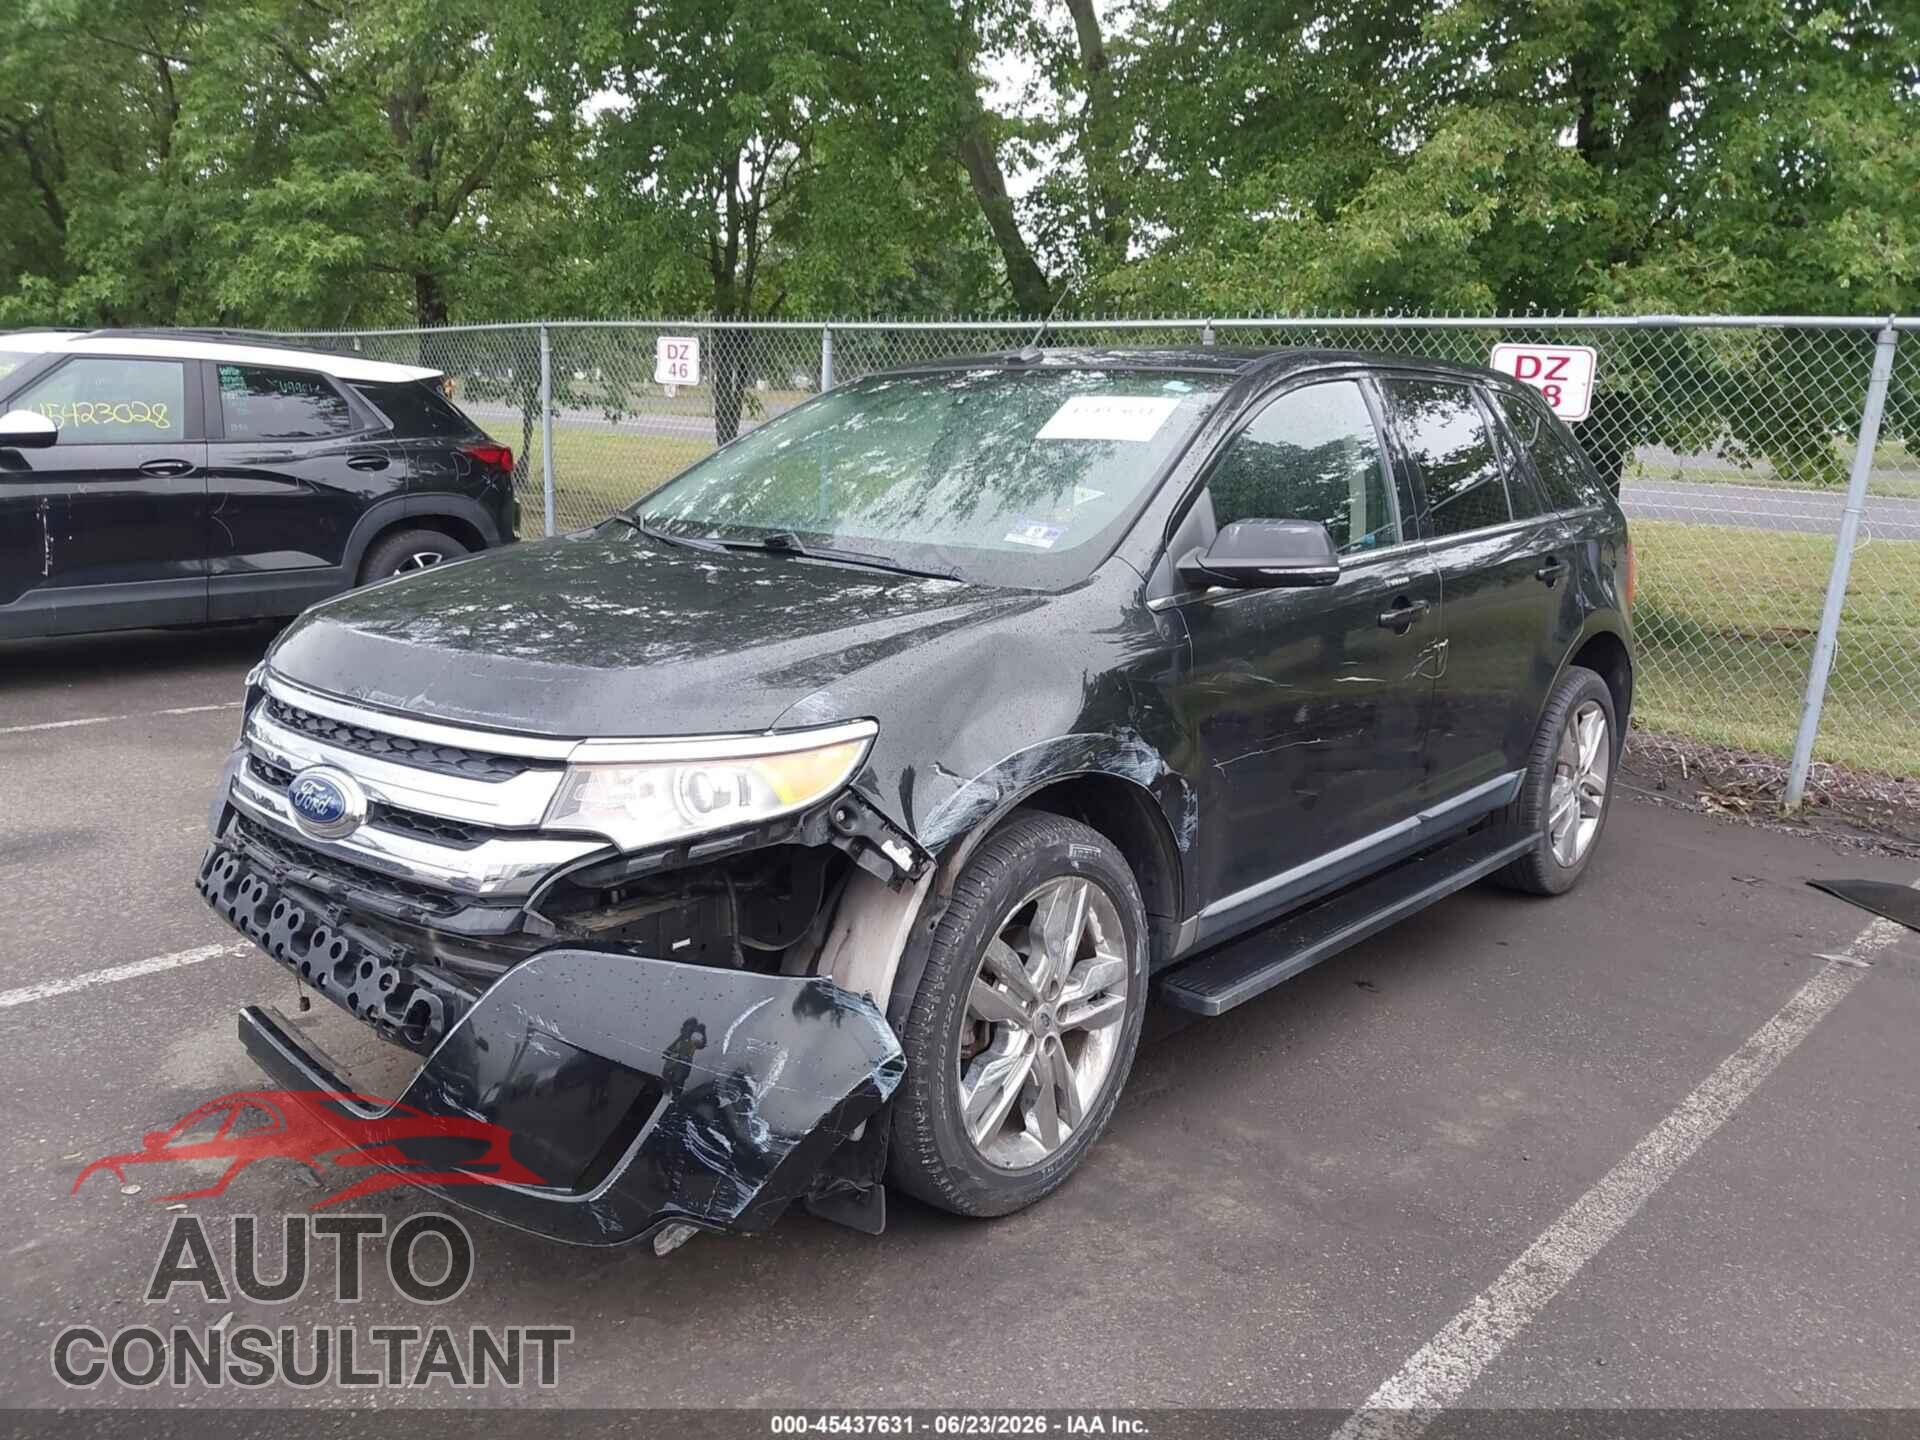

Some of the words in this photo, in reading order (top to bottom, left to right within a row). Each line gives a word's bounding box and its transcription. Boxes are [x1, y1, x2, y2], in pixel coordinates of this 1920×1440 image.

[667, 344, 689, 360] DZ
[668, 363, 688, 378] 46
[1514, 354, 1571, 381] DZ
[1541, 384, 1562, 408] 8
[294, 780, 333, 815] Ford
